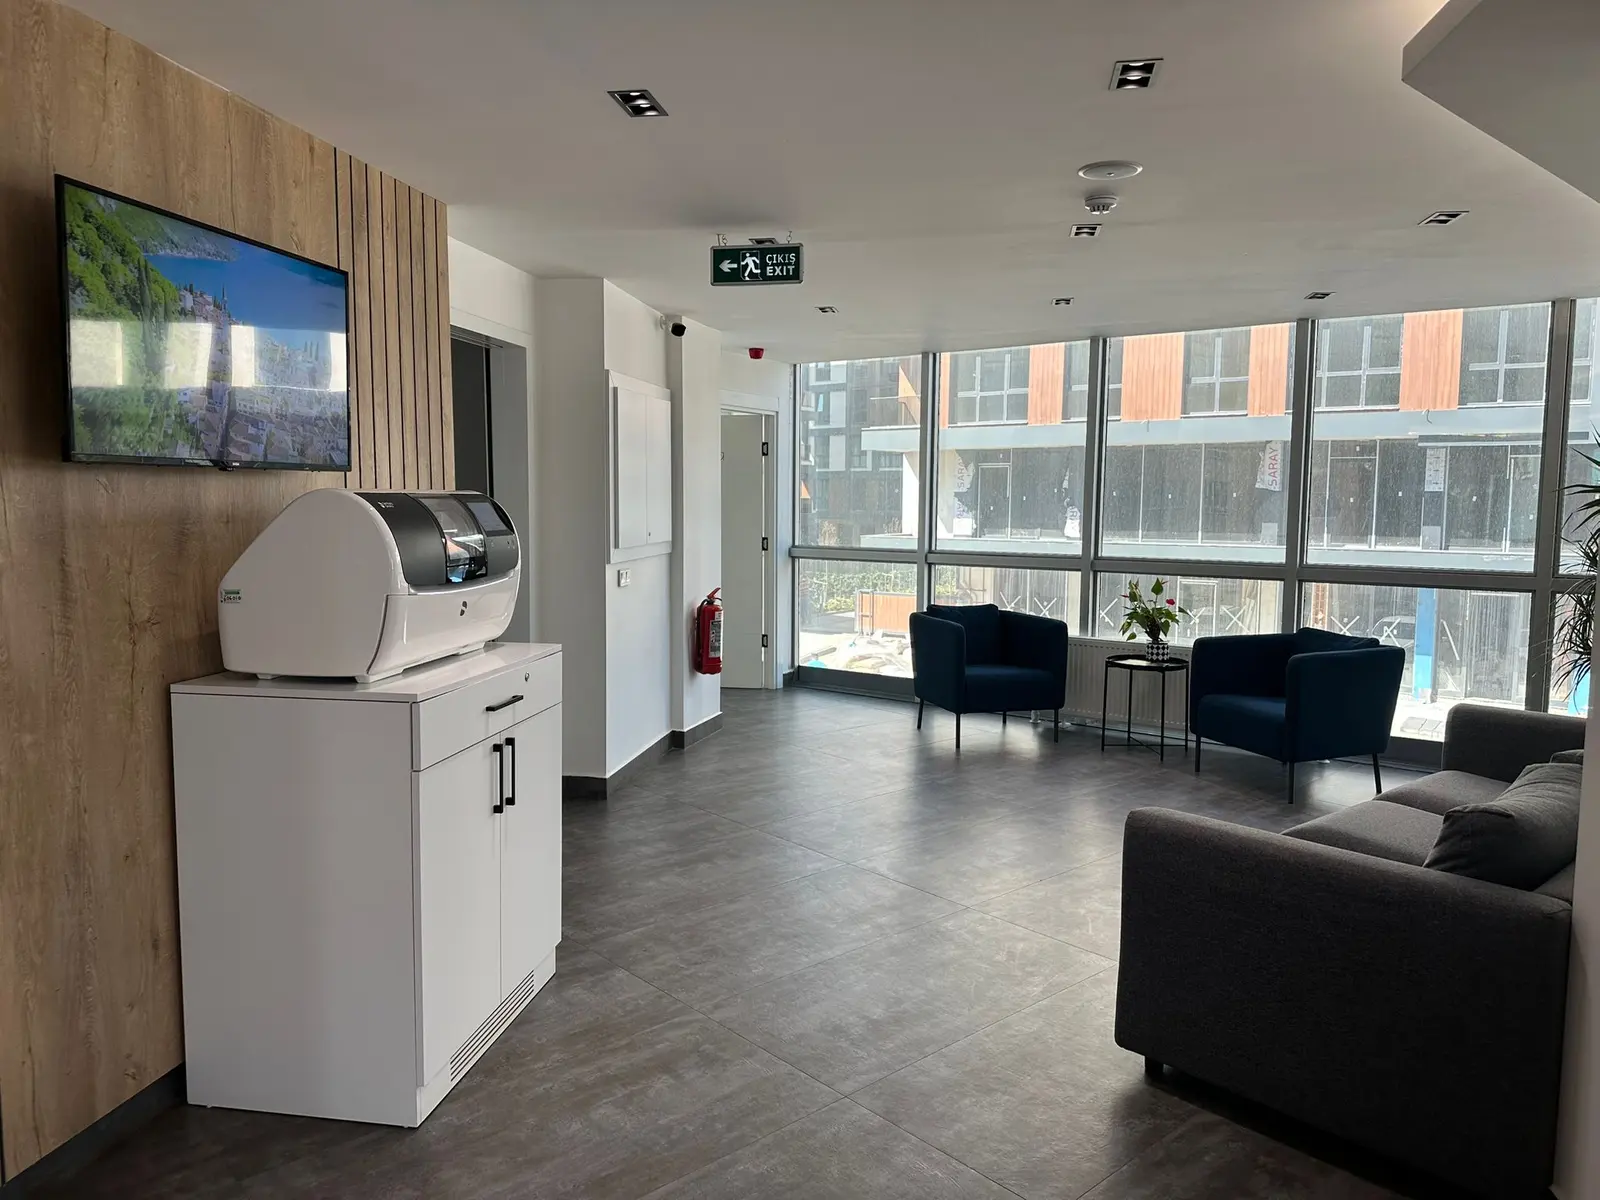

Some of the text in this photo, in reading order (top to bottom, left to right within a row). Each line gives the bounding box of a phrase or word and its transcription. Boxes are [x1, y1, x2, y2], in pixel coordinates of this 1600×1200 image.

[766, 253, 796, 265] ÇIKIŞ
[766, 266, 796, 276] EXIT
[1267, 447, 1278, 487] SARAY
